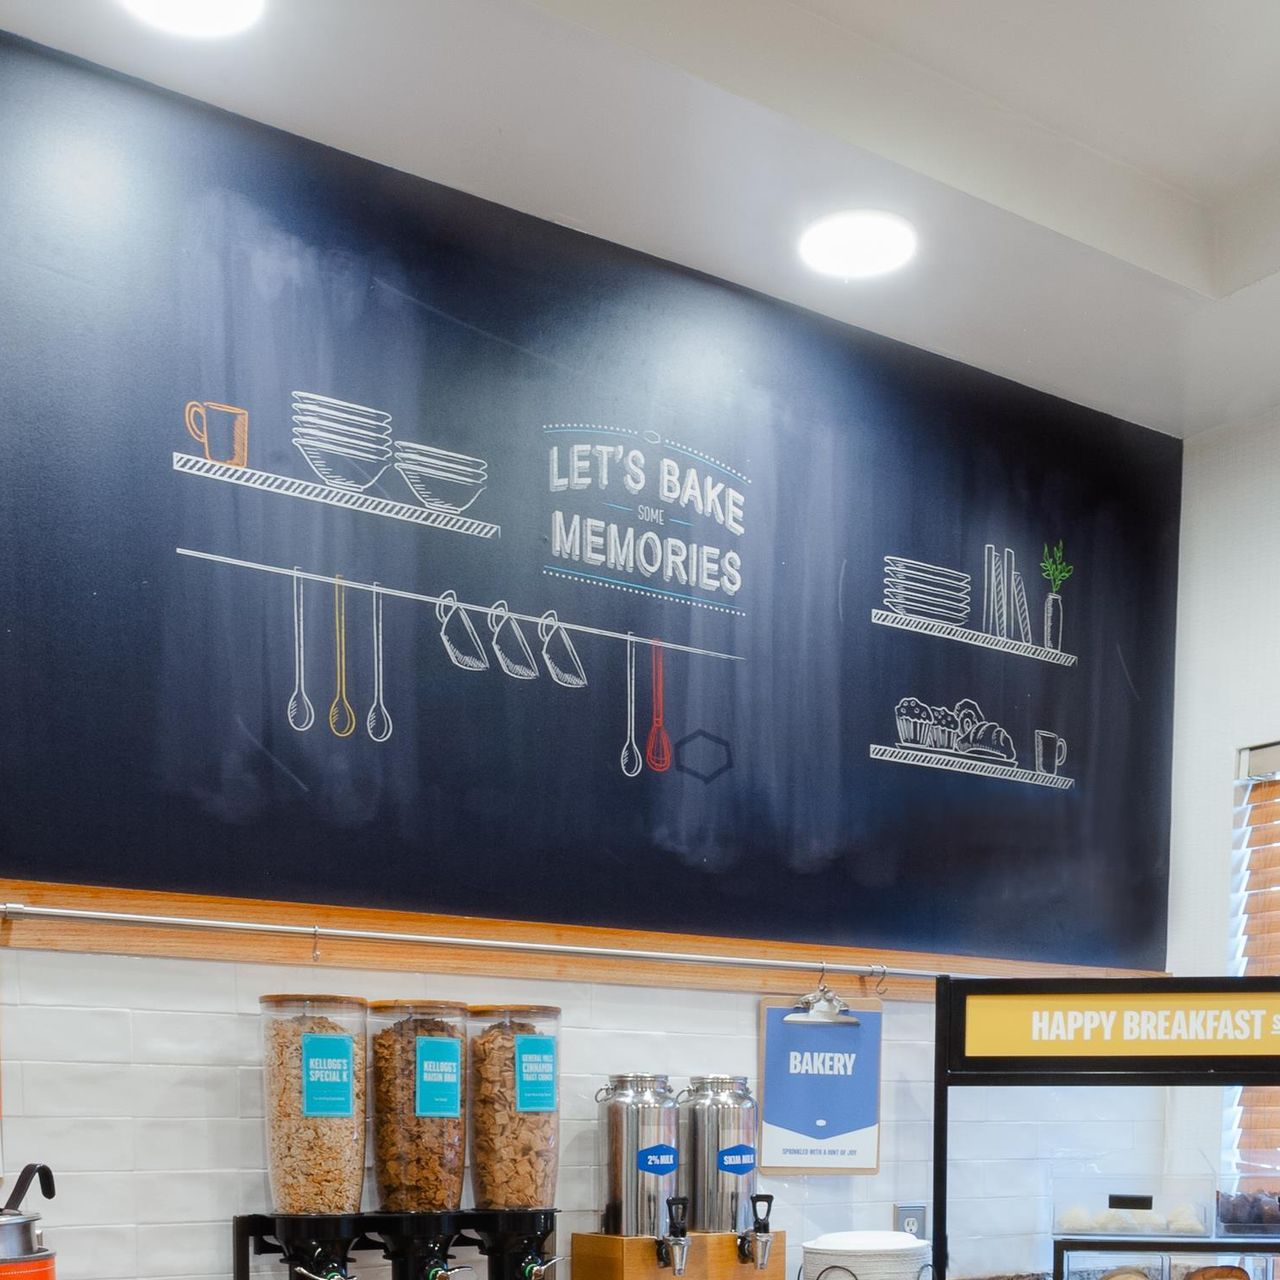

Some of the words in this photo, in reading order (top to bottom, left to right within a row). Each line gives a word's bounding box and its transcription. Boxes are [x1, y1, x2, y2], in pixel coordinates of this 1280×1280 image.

[549, 444, 646, 495] LET'S
[659, 458, 745, 536] BAKE
[637, 505, 665, 525] SOME
[551, 510, 742, 596] MEMORIES
[1031, 1010, 1117, 1041] HAPPY
[1123, 1009, 1267, 1041] BREAKFAST
[309, 1058, 347, 1070] KELLOGG'S
[789, 1051, 856, 1075] BAKERY
[309, 1070, 340, 1082] SPECIAL
[343, 1070, 348, 1082] K
[648, 1155, 660, 1165] 2%
[724, 1155, 742, 1165] SKIM
